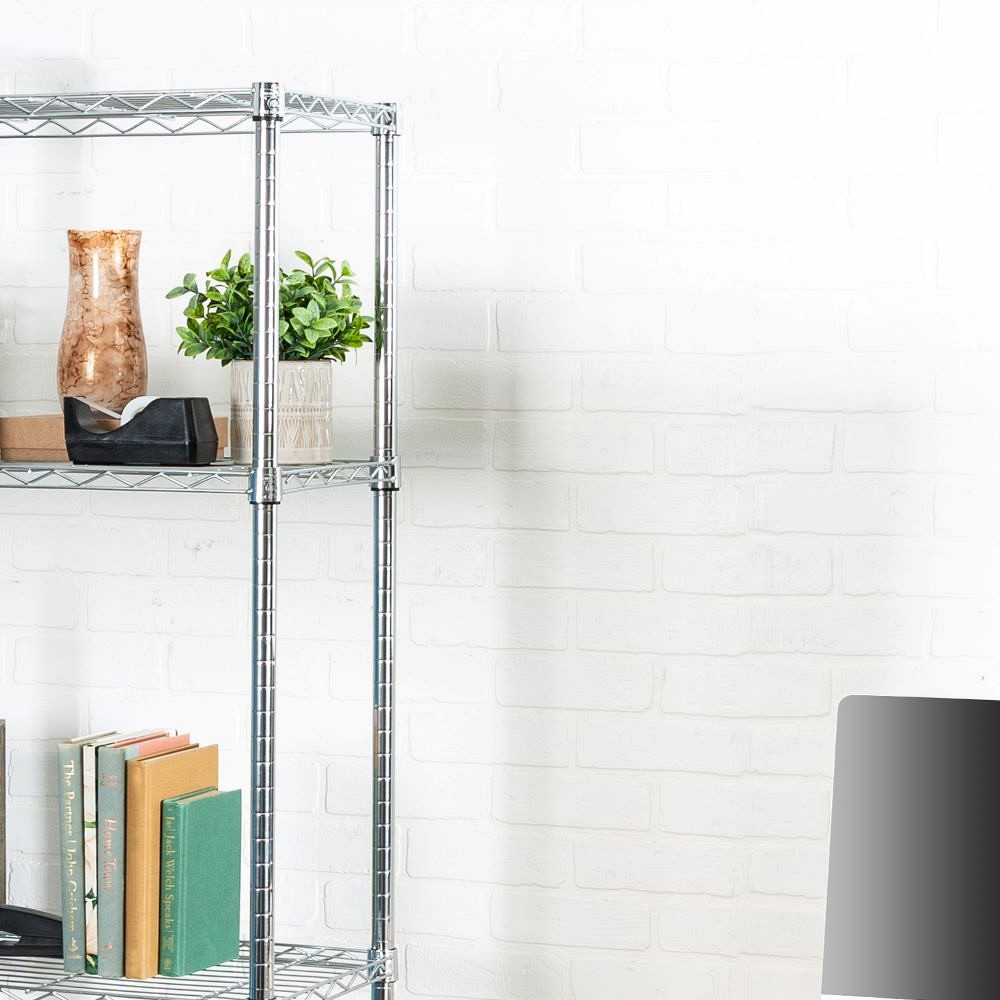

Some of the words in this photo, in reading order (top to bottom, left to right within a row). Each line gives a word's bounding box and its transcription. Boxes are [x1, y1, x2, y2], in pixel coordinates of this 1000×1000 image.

[62, 760, 75, 787] The
[64, 790, 76, 837] Partner
[103, 818, 118, 856] Home
[164, 834, 176, 856] Jack
[65, 847, 77, 876] John
[165, 859, 176, 890] Welch
[162, 894, 175, 929] Speaks
